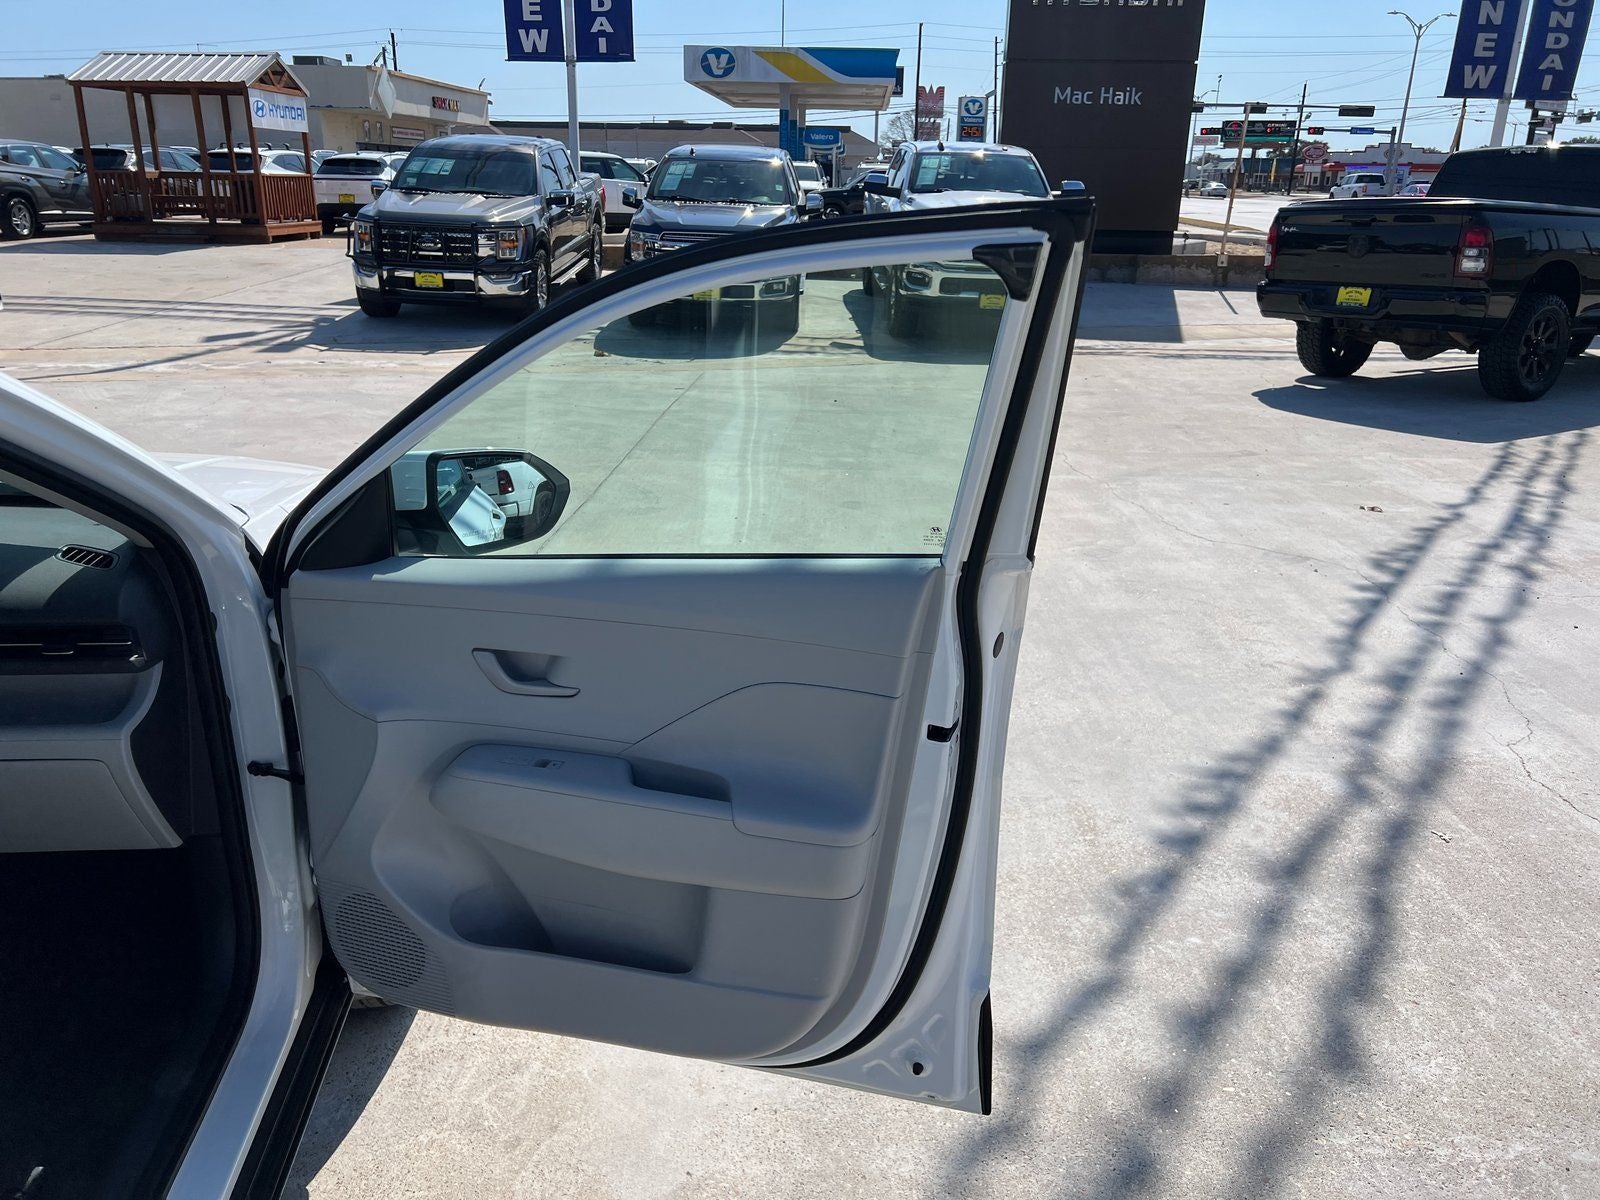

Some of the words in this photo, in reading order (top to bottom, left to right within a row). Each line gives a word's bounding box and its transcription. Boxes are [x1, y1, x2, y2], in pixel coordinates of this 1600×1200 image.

[1464, 0, 1506, 90] NEW
[1053, 86, 1093, 105] Mac
[1099, 86, 1144, 105] Haik
[268, 103, 306, 121] HYUNDAI
[810, 133, 834, 141] Valero
